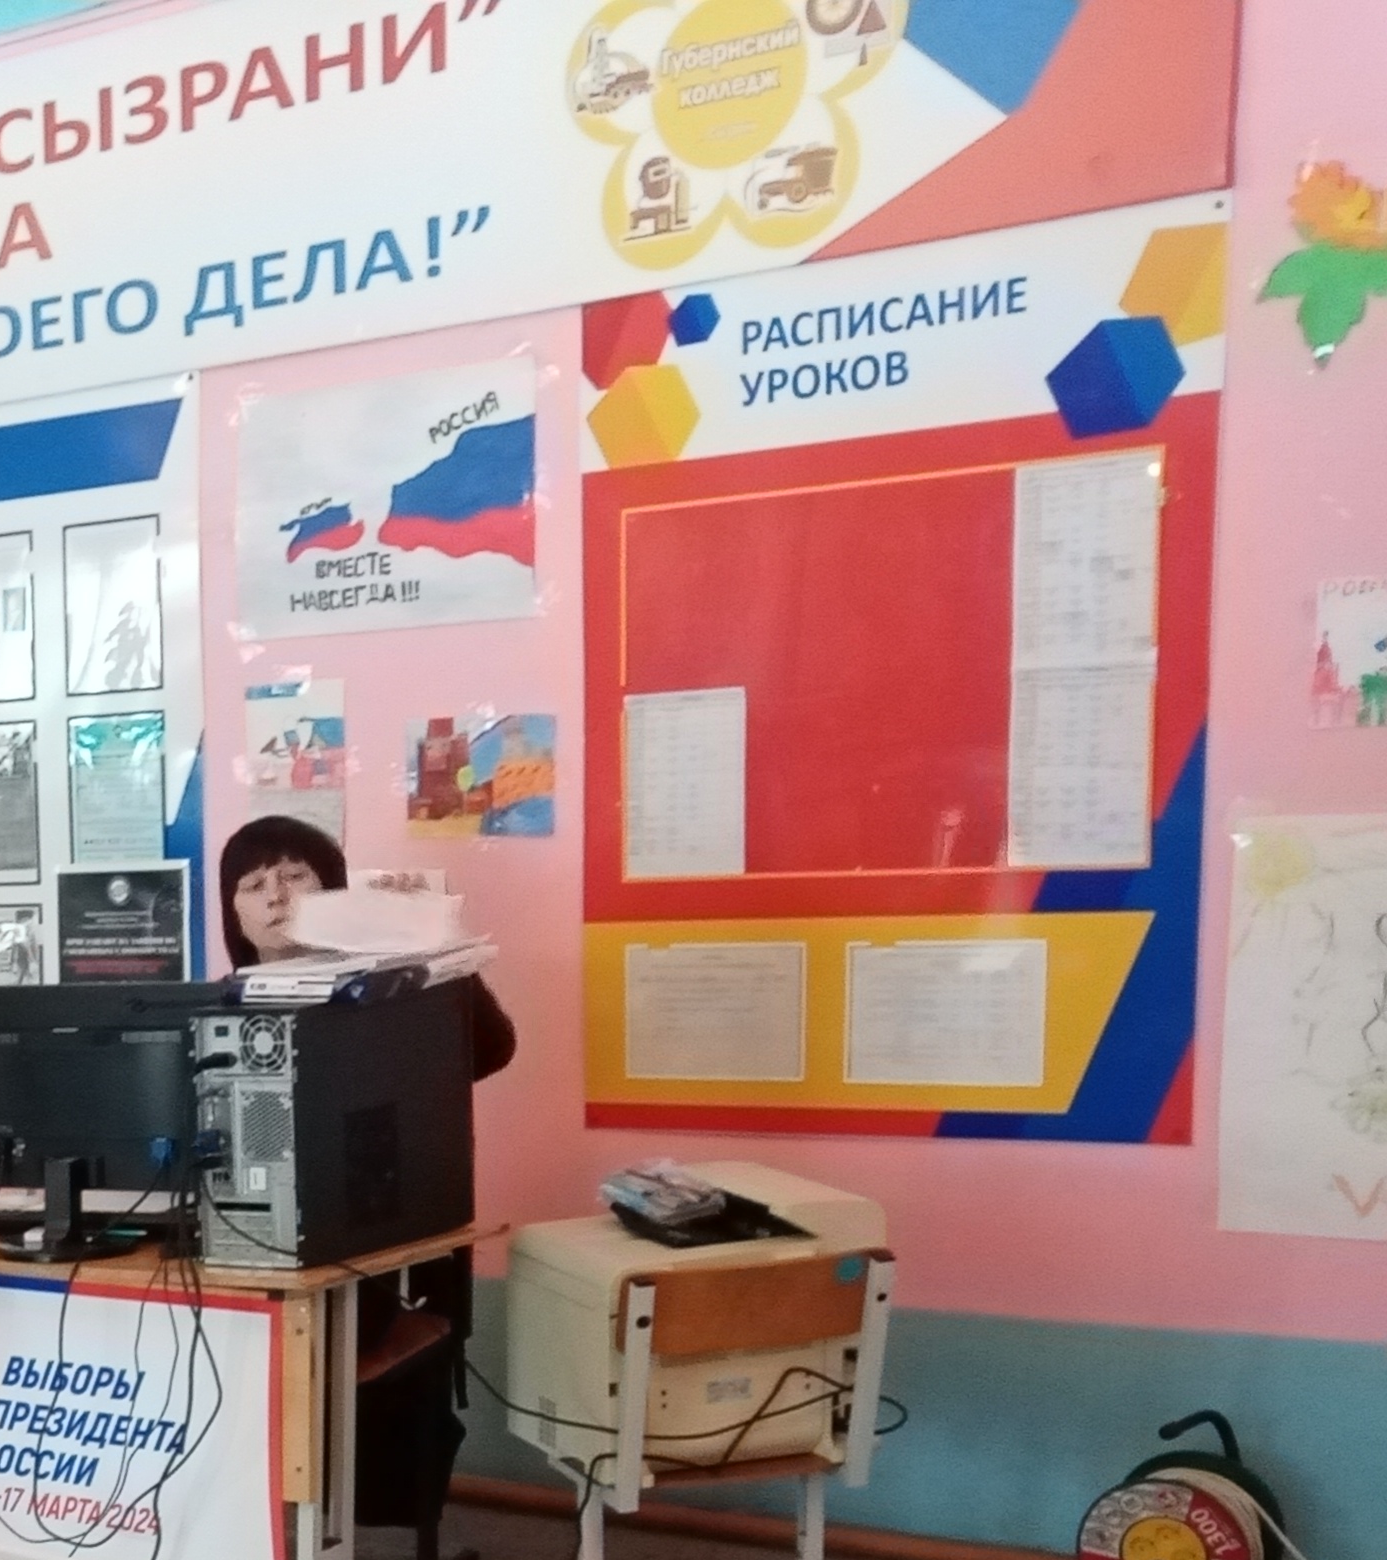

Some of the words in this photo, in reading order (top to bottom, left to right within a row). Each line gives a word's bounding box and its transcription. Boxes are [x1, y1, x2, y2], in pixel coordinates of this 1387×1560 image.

[660, 22, 802, 78] Губернский
[677, 66, 781, 111] колледж
[741, 276, 1028, 355] РАСПИСАНИЕ
[740, 350, 909, 407] УРОКОВ
[428, 391, 501, 443] РОССИЯ
[315, 552, 392, 579] ВМЕСТЕ
[2, 1356, 146, 1401] ВЫБОРЫ
[26, 1493, 104, 1527] МАРТА
[105, 1503, 162, 1537] 2024
[1191, 1509, 1229, 1556] 1300
